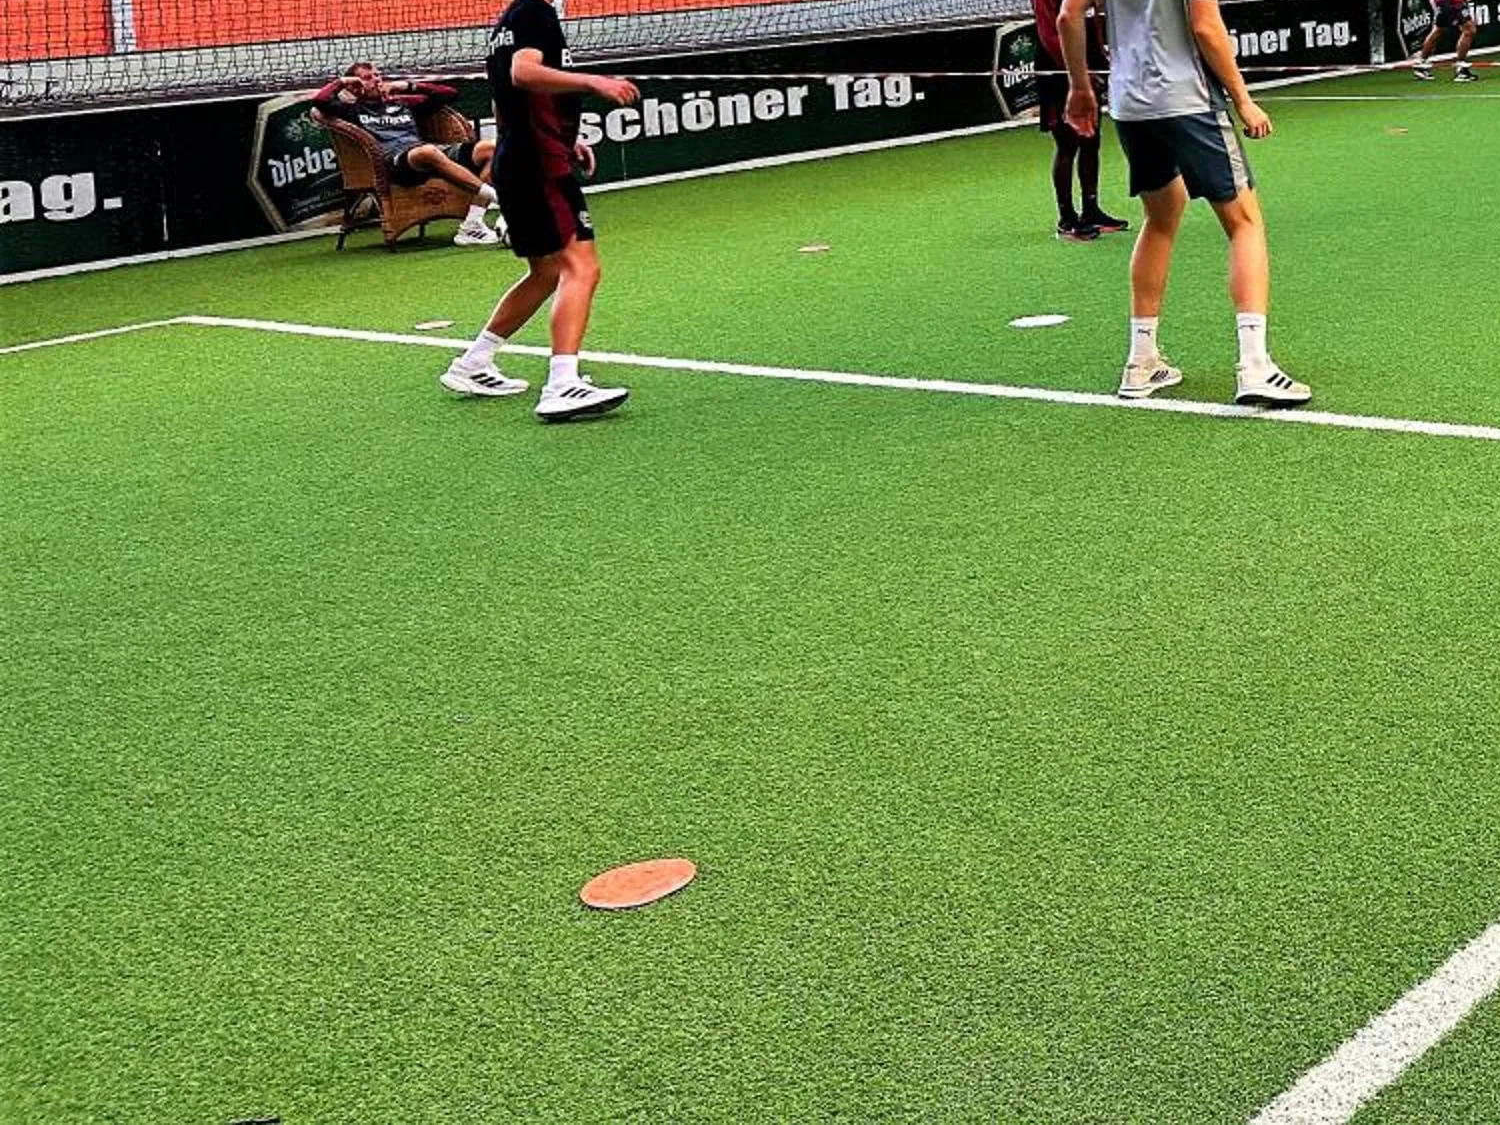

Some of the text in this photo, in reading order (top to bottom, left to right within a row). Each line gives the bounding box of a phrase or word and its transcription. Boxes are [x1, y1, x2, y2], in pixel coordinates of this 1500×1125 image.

[1300, 19, 1357, 48] Tag.
[578, 75, 926, 147] schöner Tag.
[267, 146, 338, 187] Diebe
[0, 171, 123, 224] ag.
